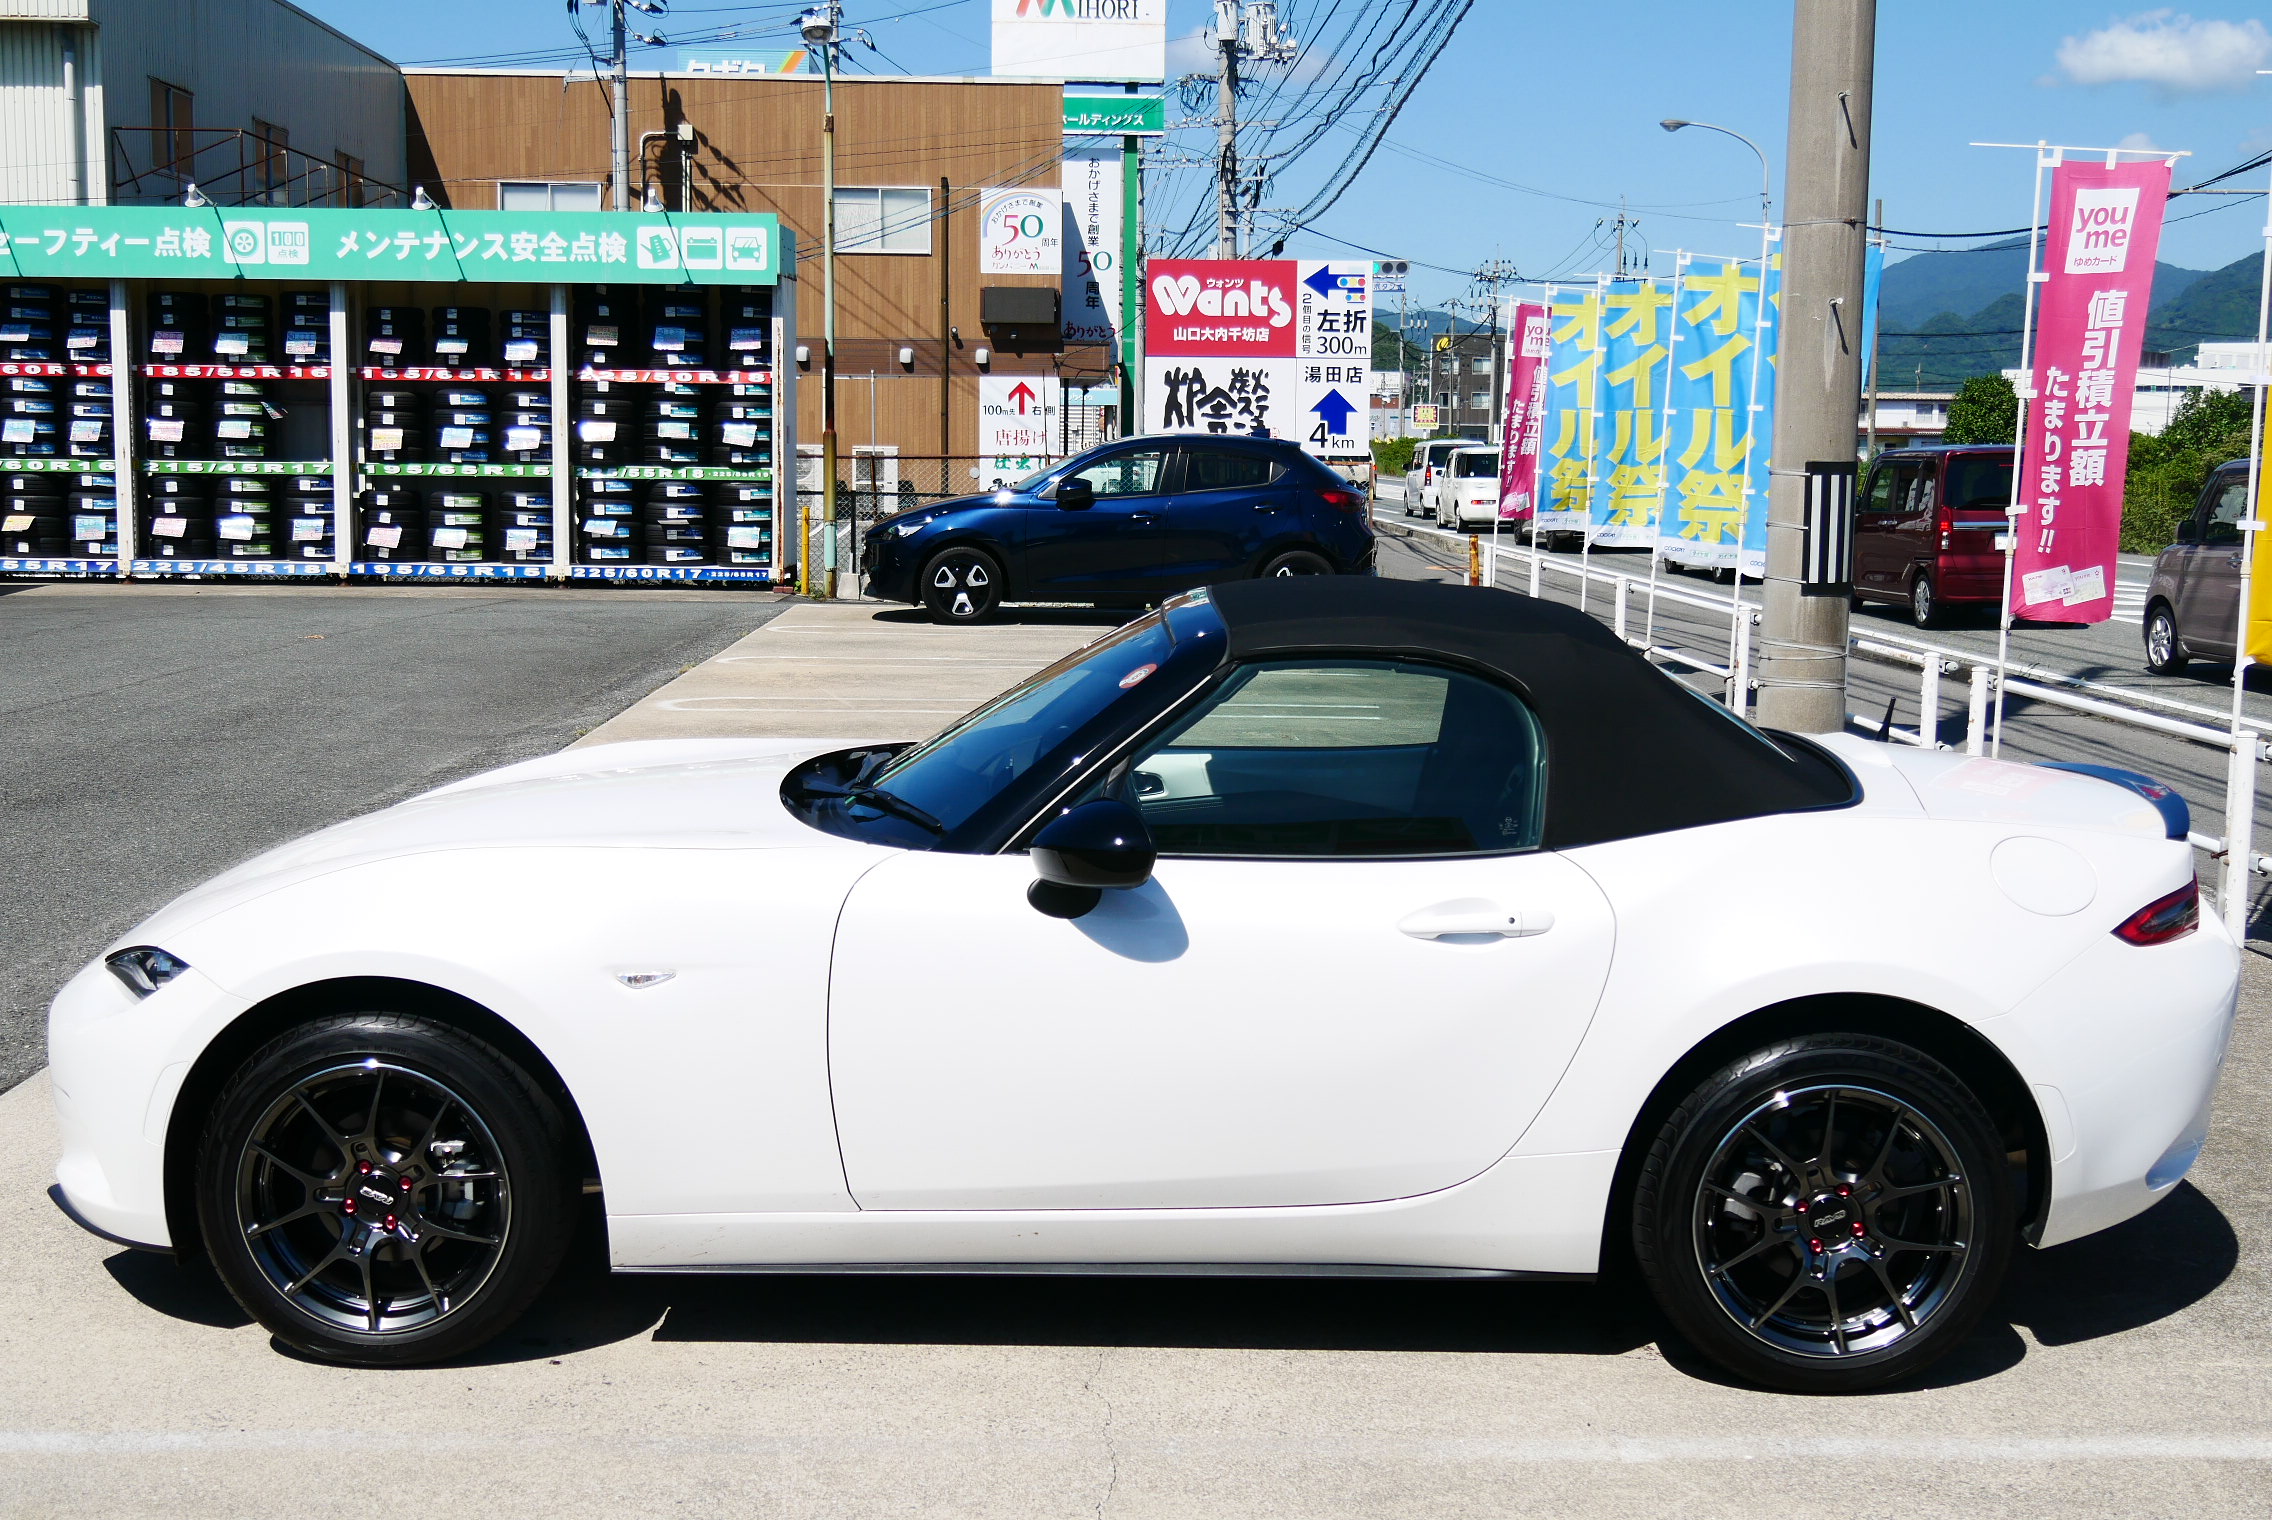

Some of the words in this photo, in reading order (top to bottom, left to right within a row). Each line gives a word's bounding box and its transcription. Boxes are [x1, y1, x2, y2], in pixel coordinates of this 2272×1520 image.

[1088, 157, 1101, 247] おかげさまで創業
[2076, 206, 2130, 234] you
[271, 231, 305, 246] 100
[1003, 214, 1044, 247] 50
[2083, 228, 2128, 250] me
[336, 230, 628, 264] メンテナンス安全点検
[1041, 237, 1058, 247] 周年
[991, 245, 1041, 261] ありがとう
[2073, 255, 2118, 267] ゆめカード
[1077, 250, 1113, 278] 50
[1206, 278, 1245, 288] ウォンツ
[1085, 281, 1100, 310] 周年
[1151, 274, 1292, 328] Wants
[1063, 321, 1116, 339] ありがとう
[1301, 293, 1312, 355] 2個目の信号
[1316, 309, 1368, 334] 左折
[1173, 327, 1270, 342] 山口大内千坊店
[1316, 336, 1368, 355] 300m
[143, 367, 329, 378] 185/55R16
[361, 368, 549, 380] 165/65R15
[1304, 366, 1363, 384] 湯田店
[2069, 290, 2128, 487] 値引積立額
[982, 405, 1016, 416] 100m先
[1032, 406, 1056, 416] 右側
[1548, 293, 1607, 512] オイル祭
[1603, 283, 1674, 527] オイル祭
[1676, 263, 1760, 544] オイル祭
[995, 429, 1049, 447] 唐揚げ
[143, 462, 331, 473] 215/45R17
[364, 465, 551, 476] 195/65R15
[132, 562, 322, 574] 225/45R18
[353, 565, 541, 577] 195/65R15
[573, 567, 703, 579] 225/60R17
